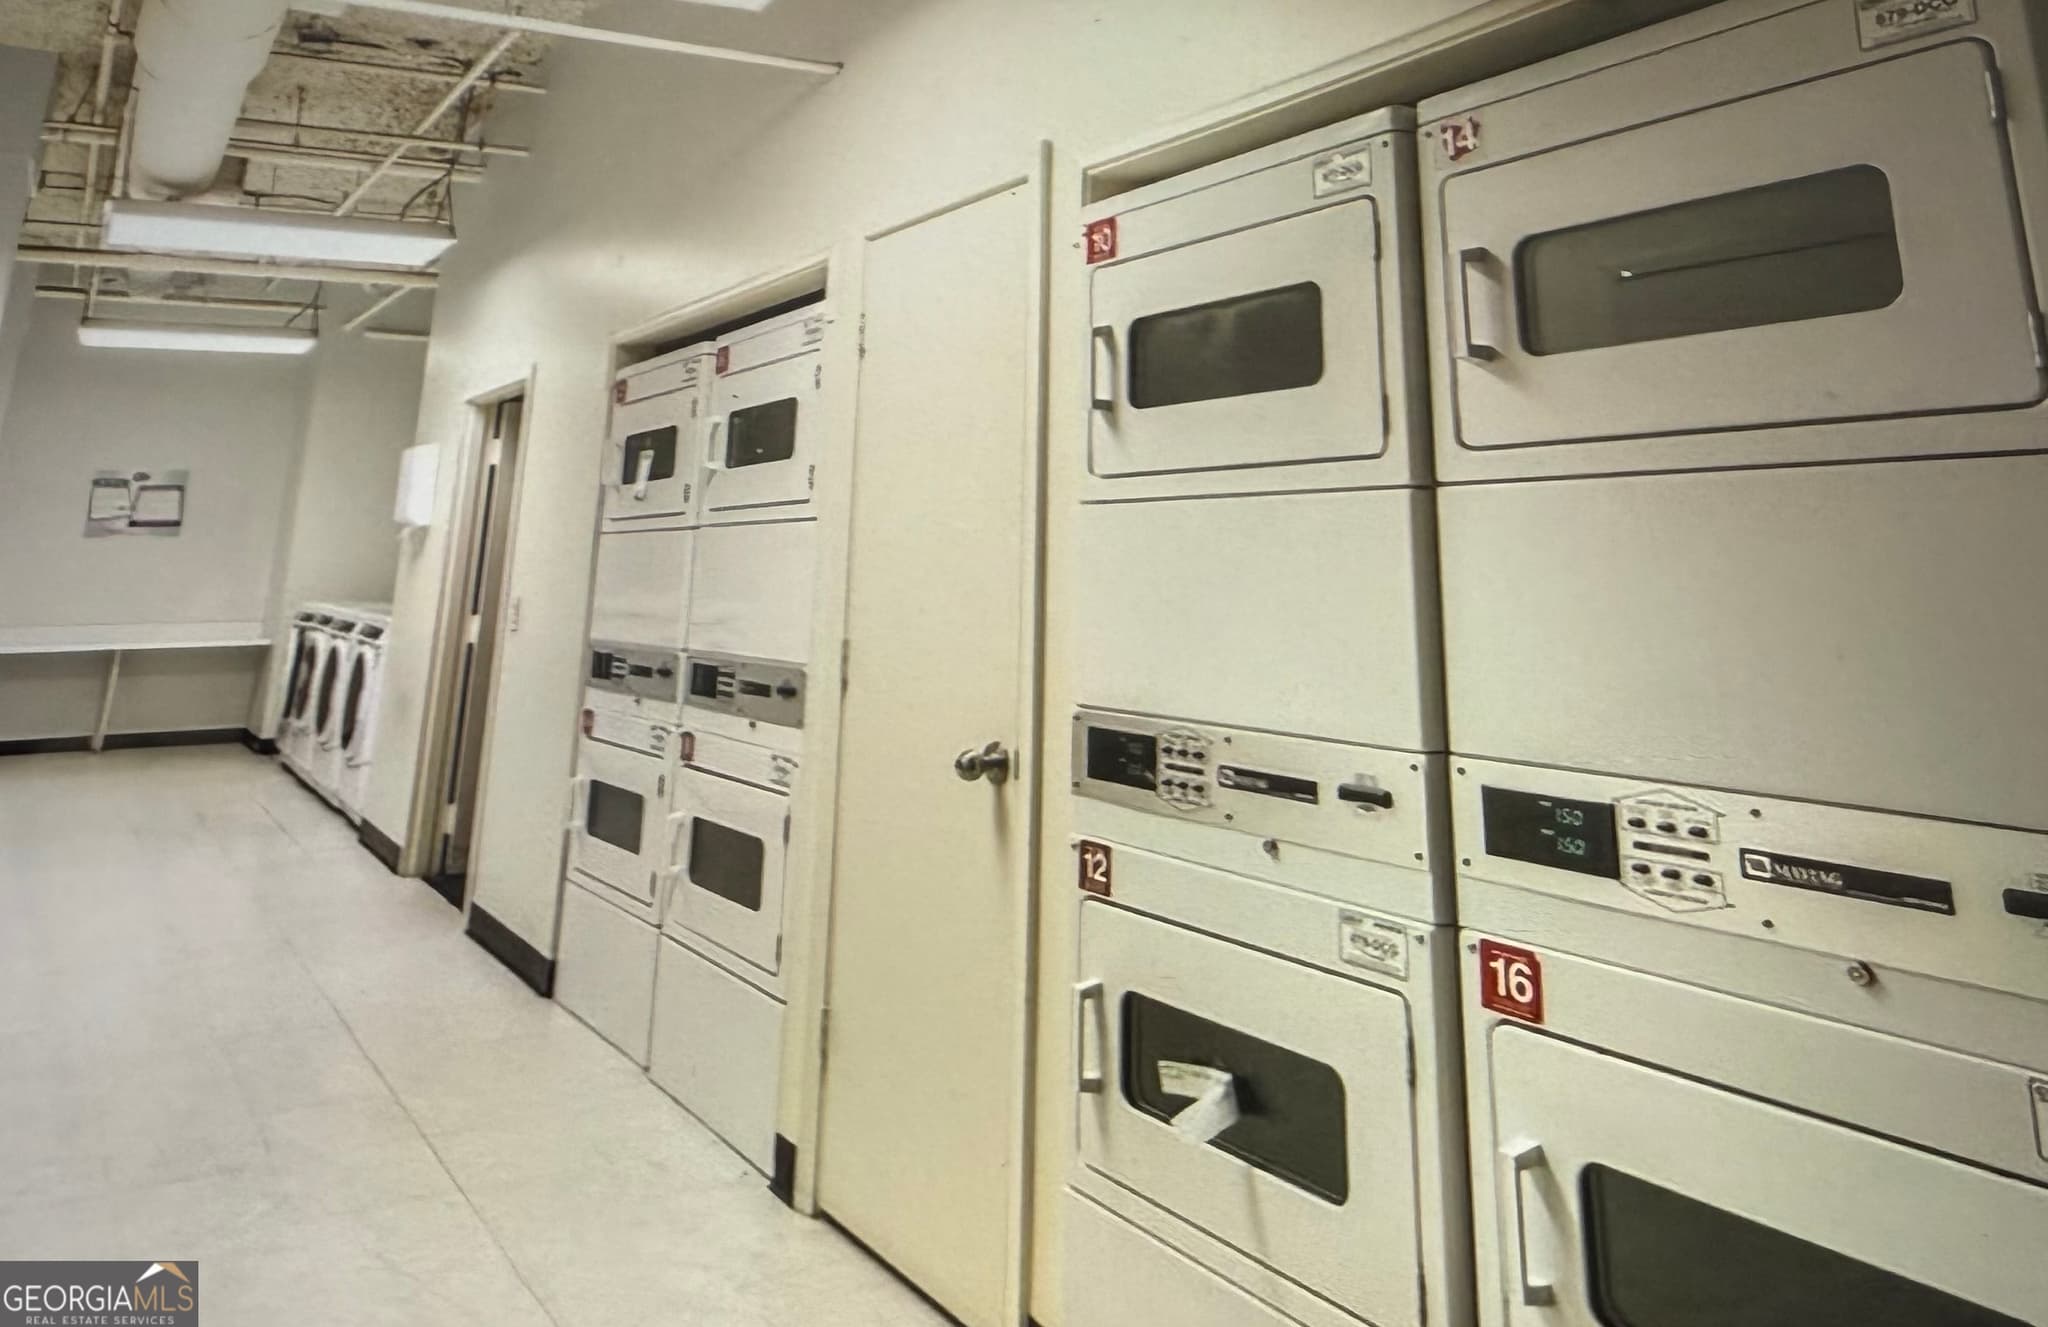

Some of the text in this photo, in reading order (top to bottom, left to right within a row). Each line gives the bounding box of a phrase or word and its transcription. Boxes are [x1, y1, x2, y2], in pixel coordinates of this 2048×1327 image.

[1442, 120, 1479, 156] 14
[1083, 853, 1107, 882] 12
[1488, 957, 1534, 1003] 16
